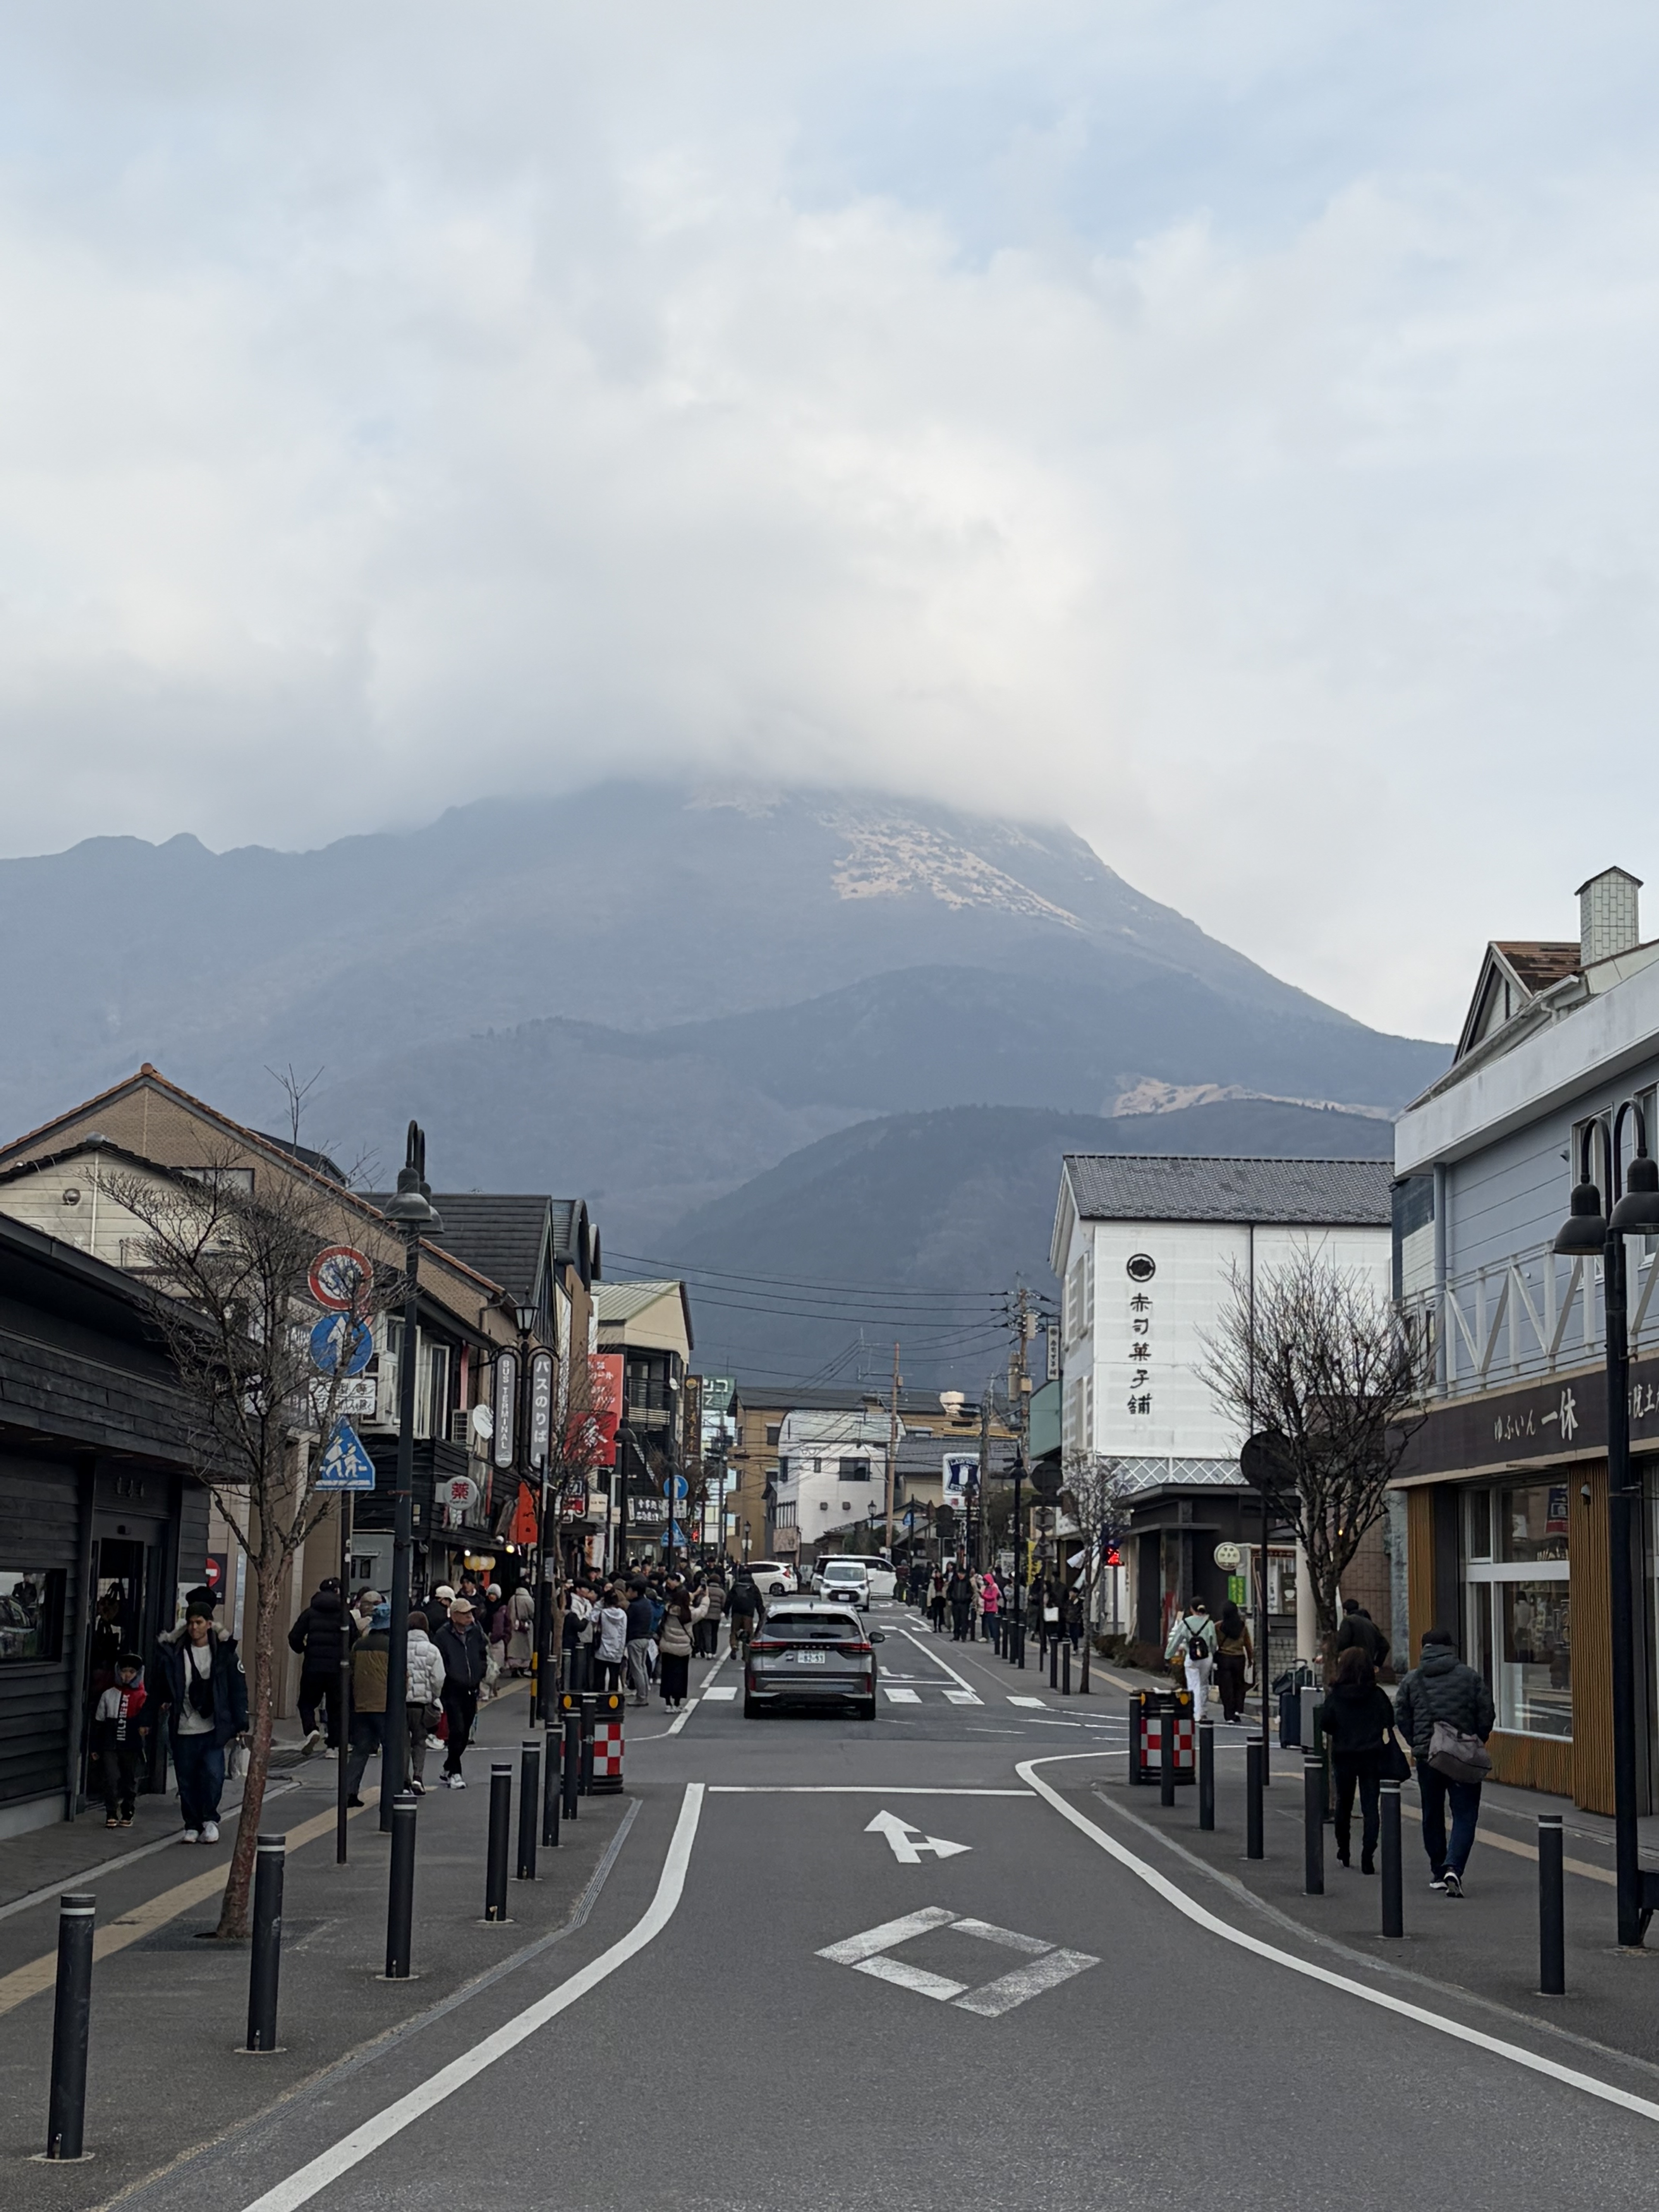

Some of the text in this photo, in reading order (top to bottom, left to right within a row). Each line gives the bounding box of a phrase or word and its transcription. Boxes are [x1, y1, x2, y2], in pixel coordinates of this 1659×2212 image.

[534, 1360, 550, 1443] バスのりば
[1127, 1292, 1153, 1415] 赤司菓子舗
